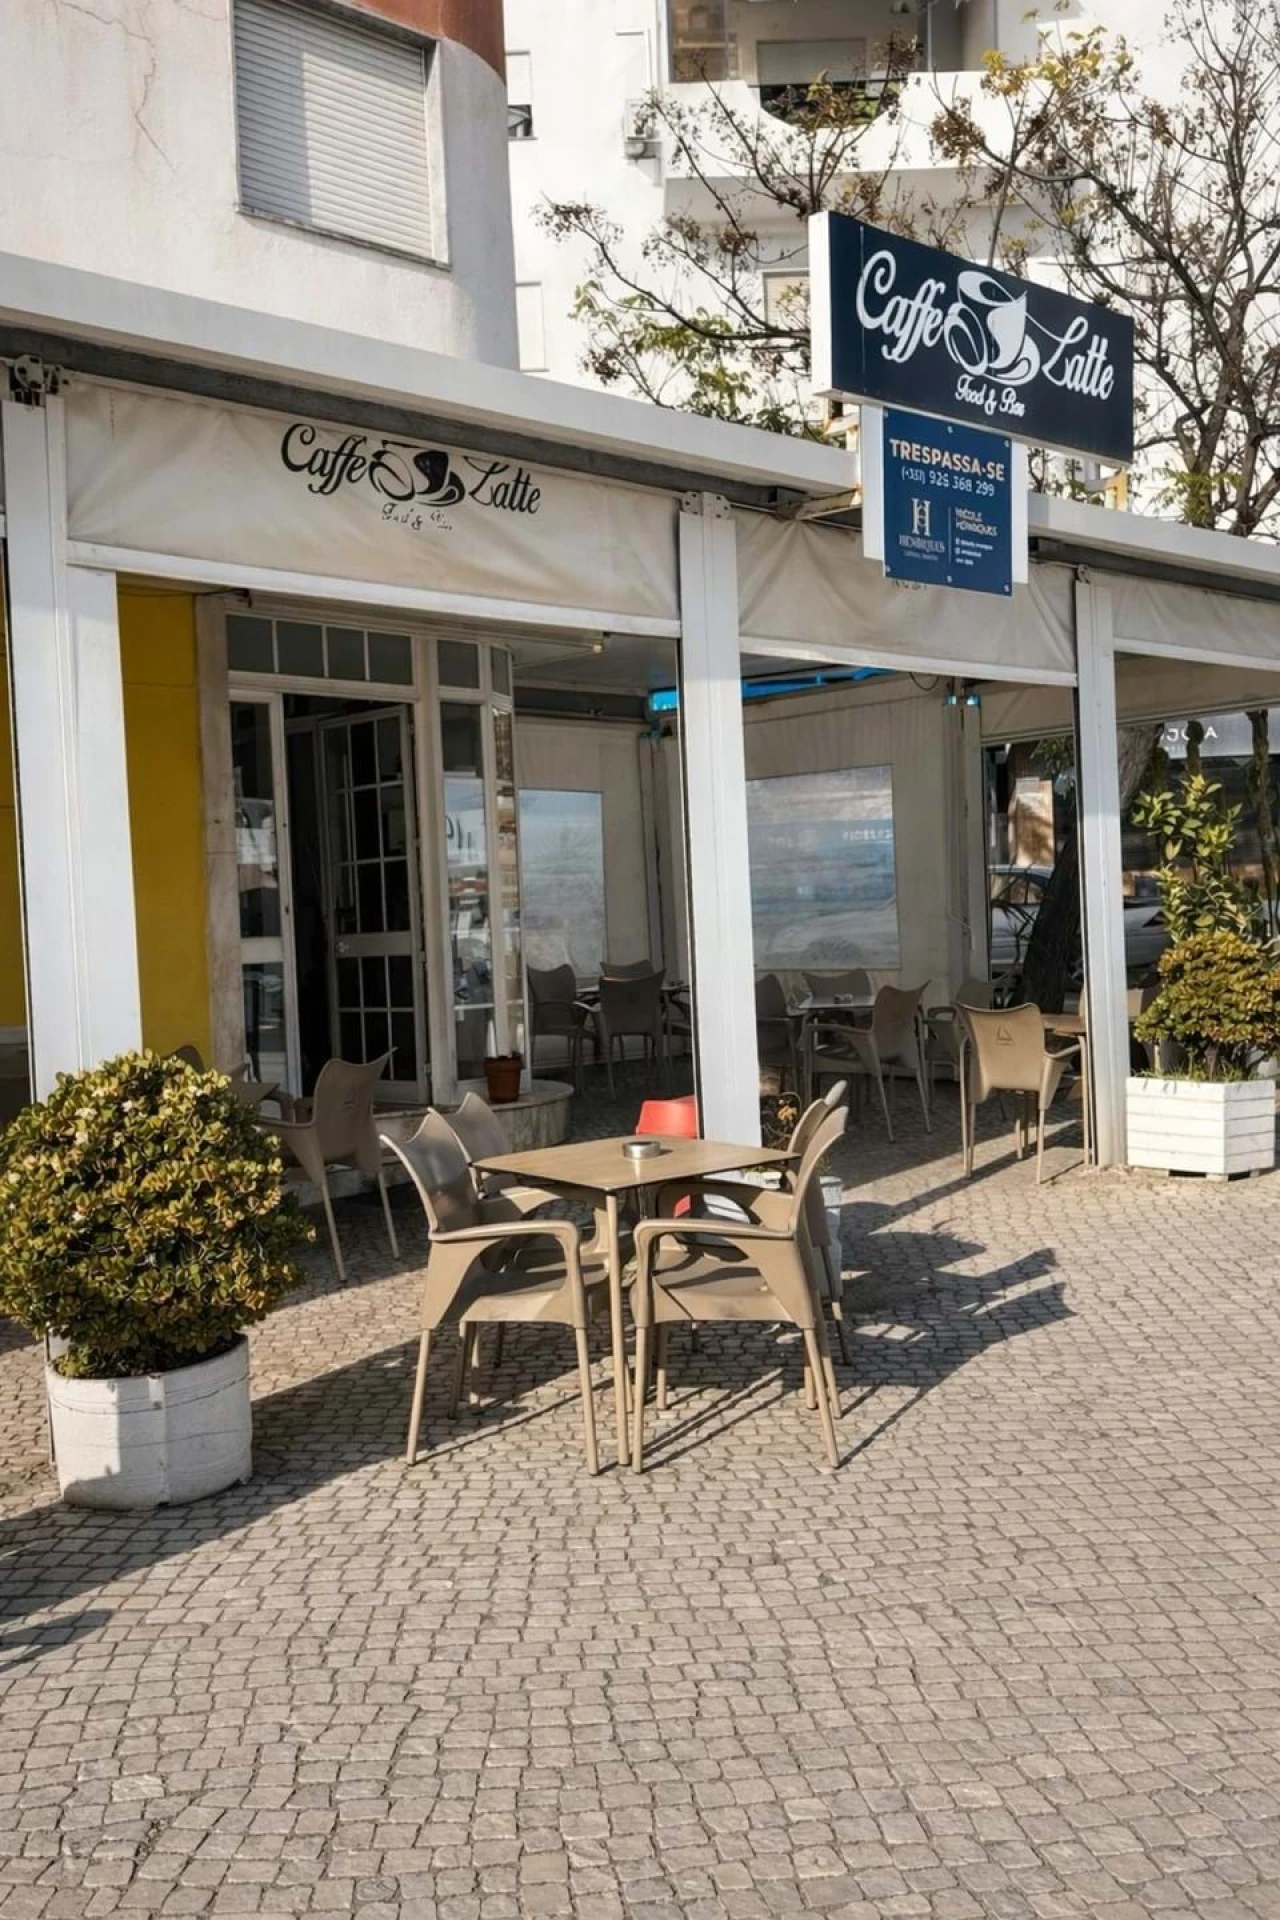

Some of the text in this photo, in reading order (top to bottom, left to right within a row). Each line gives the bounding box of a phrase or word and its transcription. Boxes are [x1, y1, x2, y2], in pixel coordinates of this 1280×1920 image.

[856, 250, 1114, 400] Caffe Latte
[955, 374, 988, 405] Food
[281, 423, 541, 515] Caffe Latte
[889, 439, 1004, 481] TRESPASSA-SE
[975, 480, 995, 496] 299
